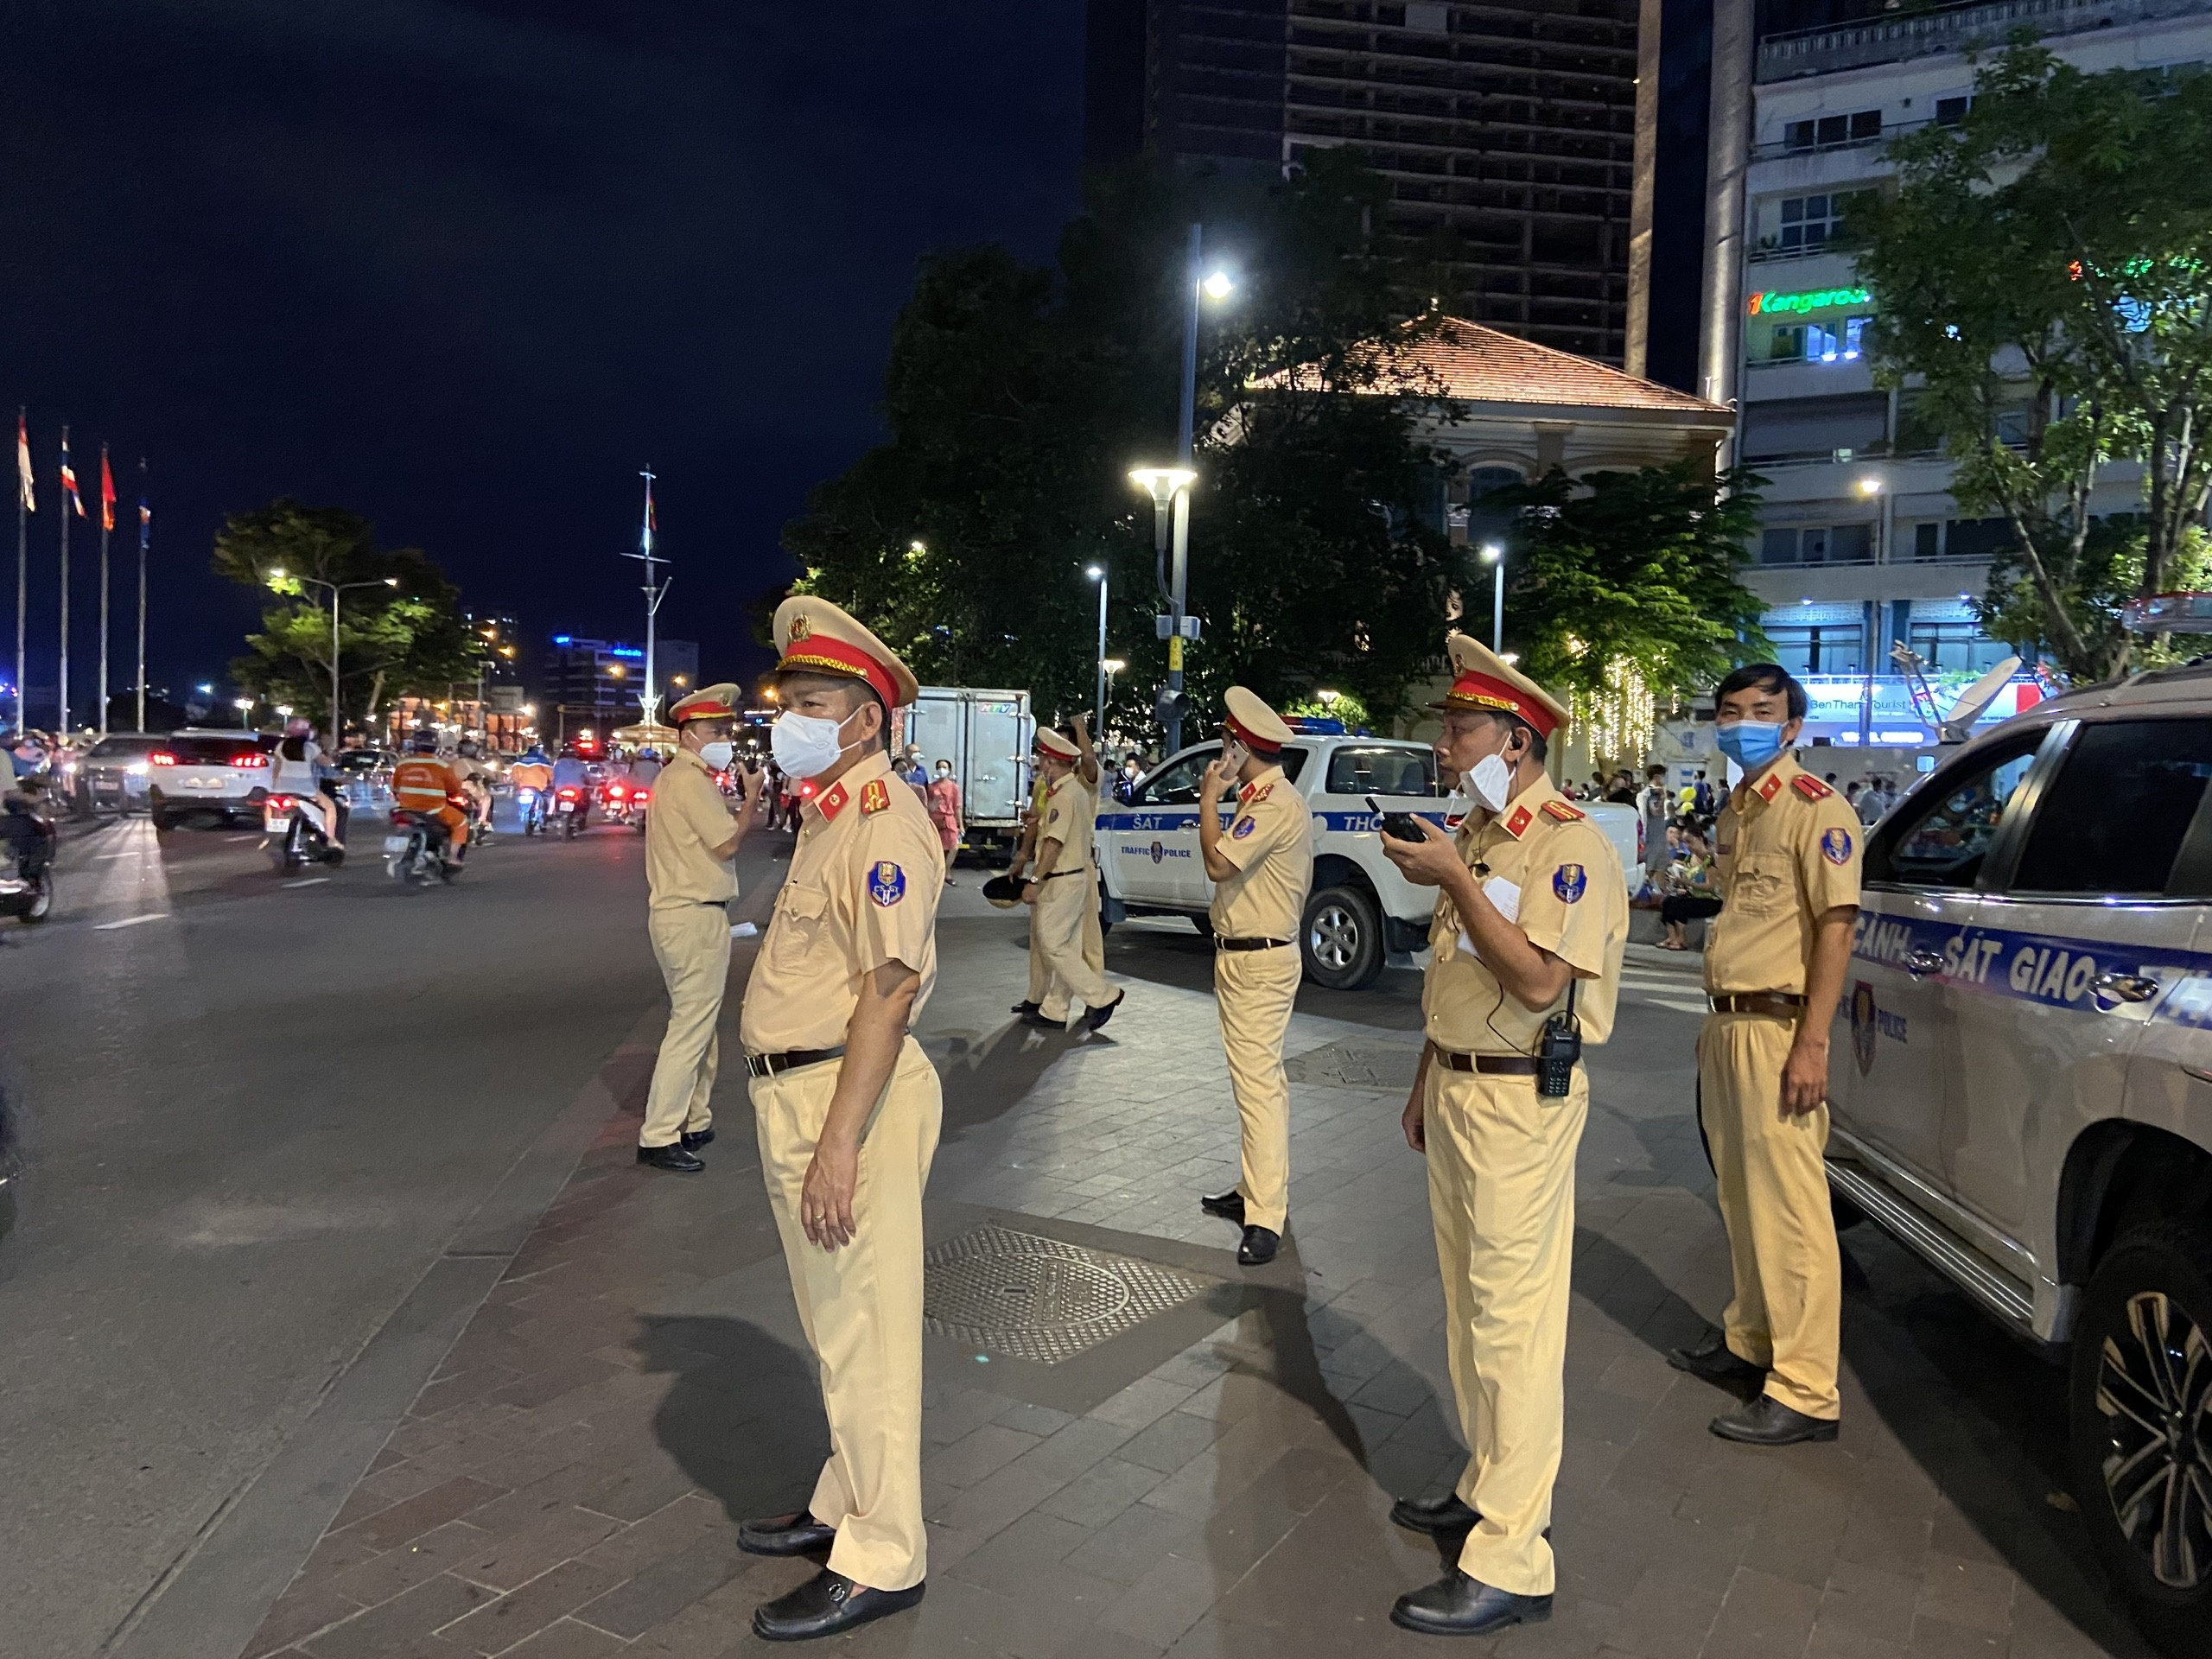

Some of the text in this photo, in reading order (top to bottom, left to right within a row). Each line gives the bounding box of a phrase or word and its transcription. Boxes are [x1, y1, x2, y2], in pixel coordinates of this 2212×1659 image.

[980, 702, 1011, 714] HTV
[1121, 846, 1191, 858] TRAFFIC POLICE
[2009, 947, 2096, 1002] GIAO
